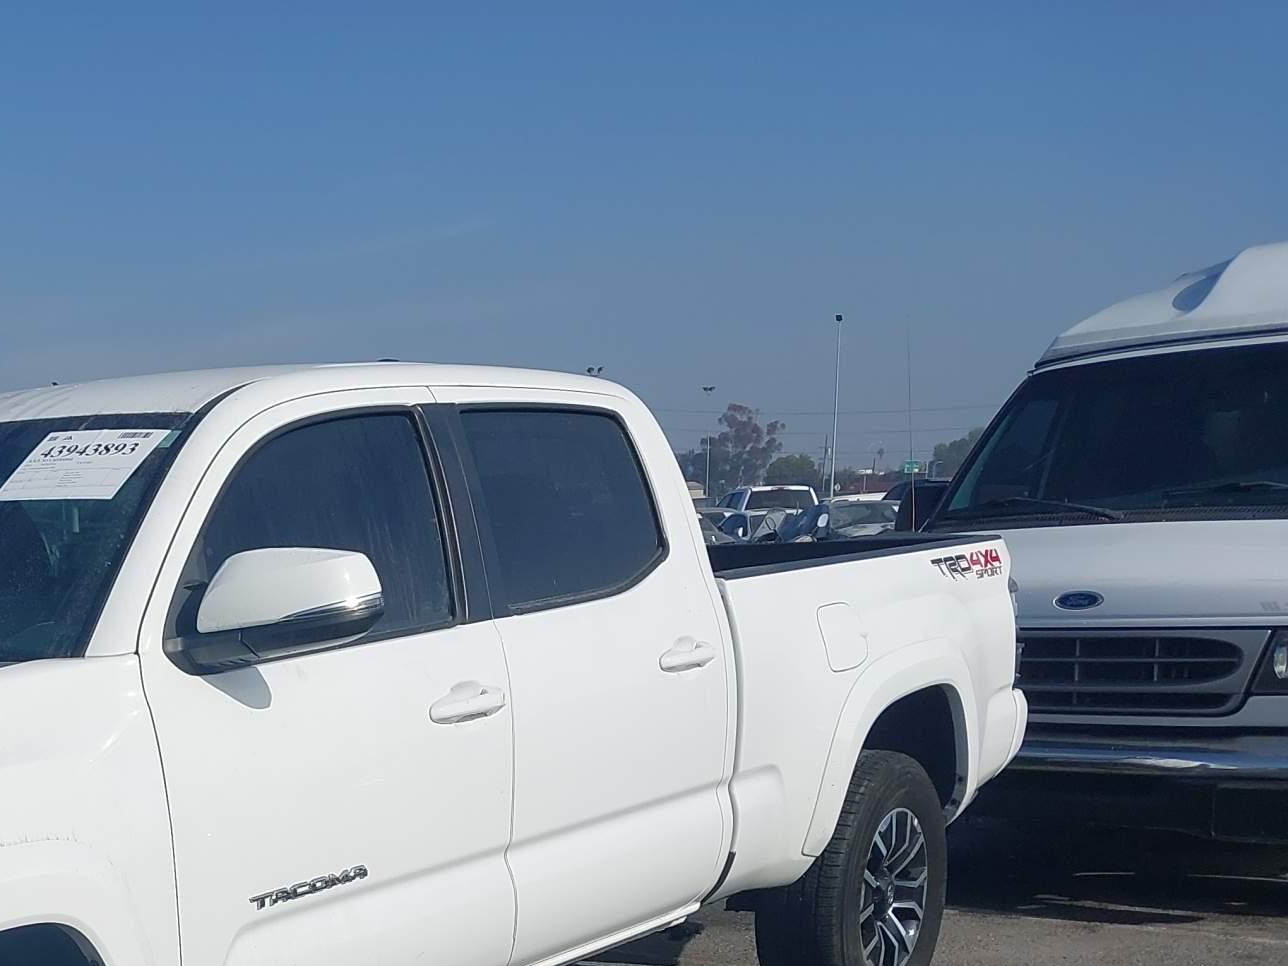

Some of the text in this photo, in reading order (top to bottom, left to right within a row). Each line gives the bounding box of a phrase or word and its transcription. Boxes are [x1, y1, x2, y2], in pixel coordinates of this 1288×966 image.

[40, 442, 140, 459] 43943893
[975, 566, 1003, 579] SPORT
[249, 864, 368, 910] TACOMA
